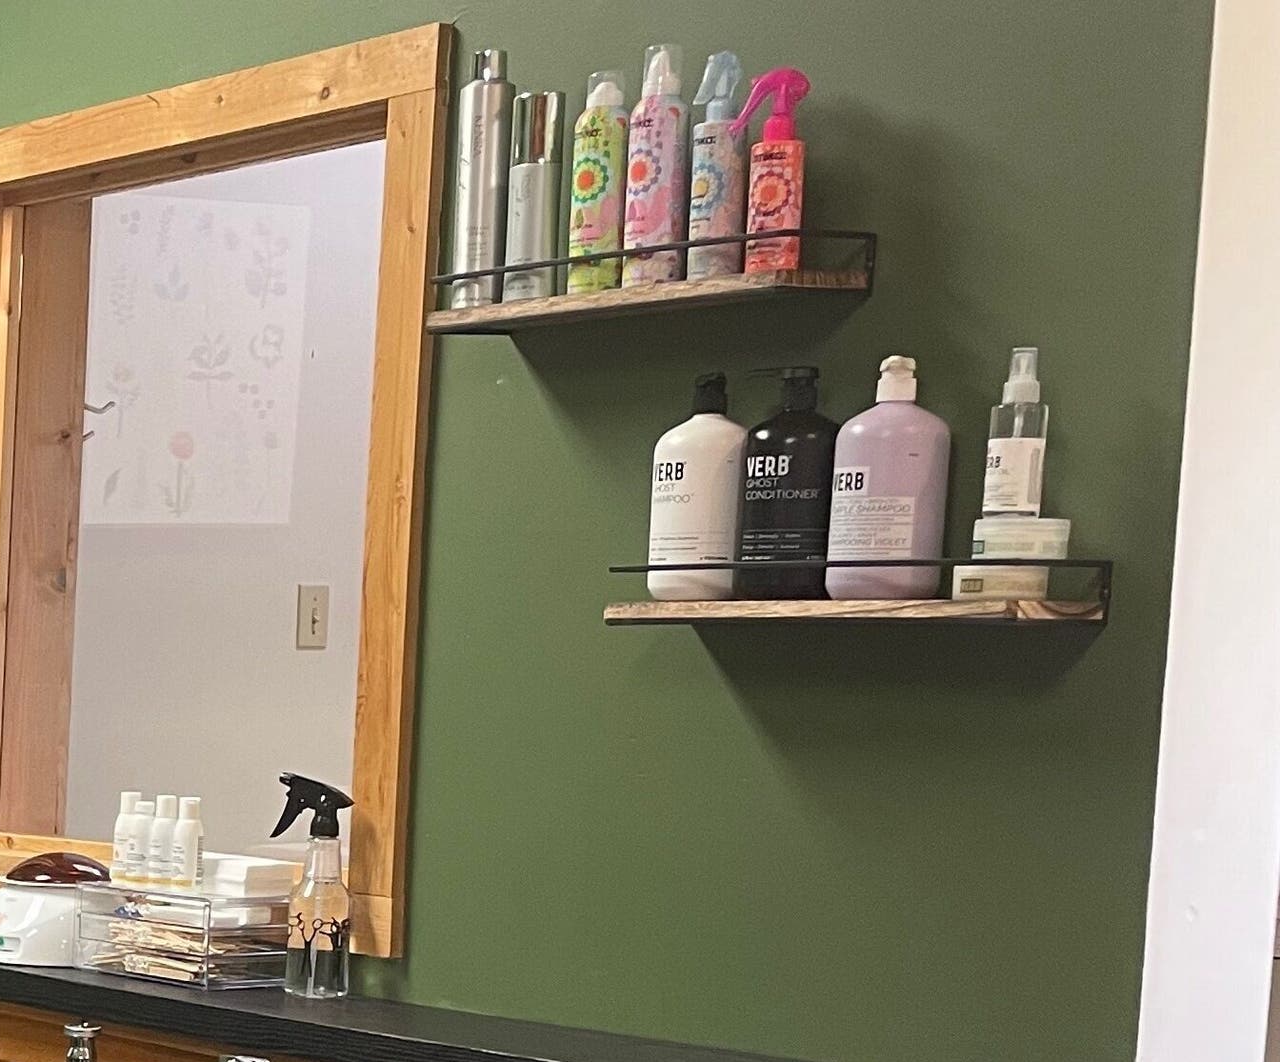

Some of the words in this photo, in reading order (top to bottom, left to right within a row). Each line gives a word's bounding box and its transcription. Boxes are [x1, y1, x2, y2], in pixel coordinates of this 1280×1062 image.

[747, 455, 790, 478] VERB
[746, 478, 779, 489] GHOST
[745, 489, 818, 501] CONDITIONER
